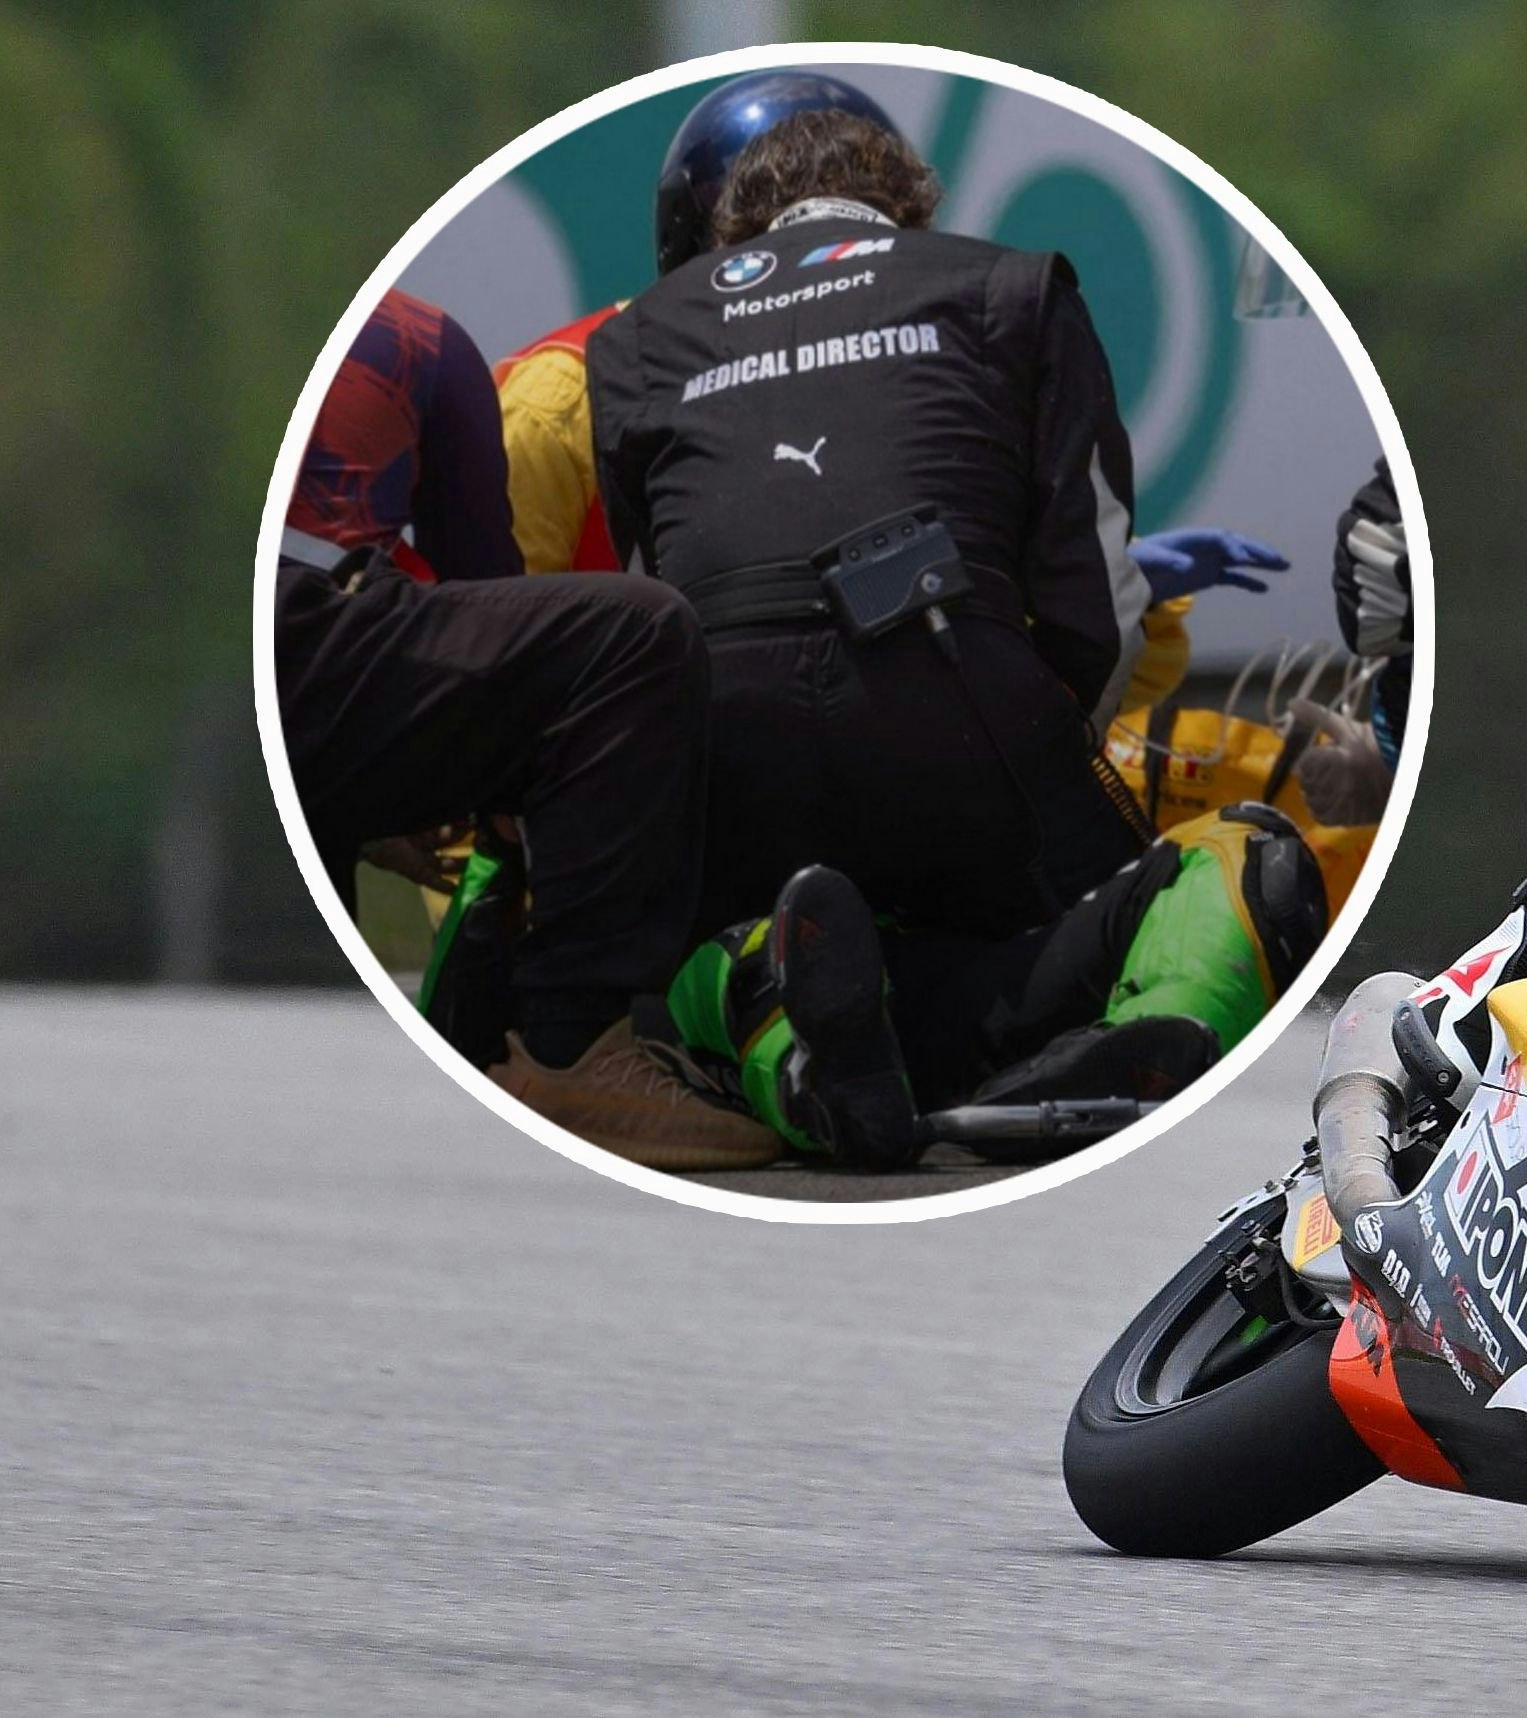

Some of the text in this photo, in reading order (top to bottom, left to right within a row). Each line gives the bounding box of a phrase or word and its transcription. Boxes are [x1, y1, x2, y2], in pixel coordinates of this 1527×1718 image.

[723, 270, 876, 323] Motorsport
[681, 322, 940, 404] MEDICAL DIRECTOR
